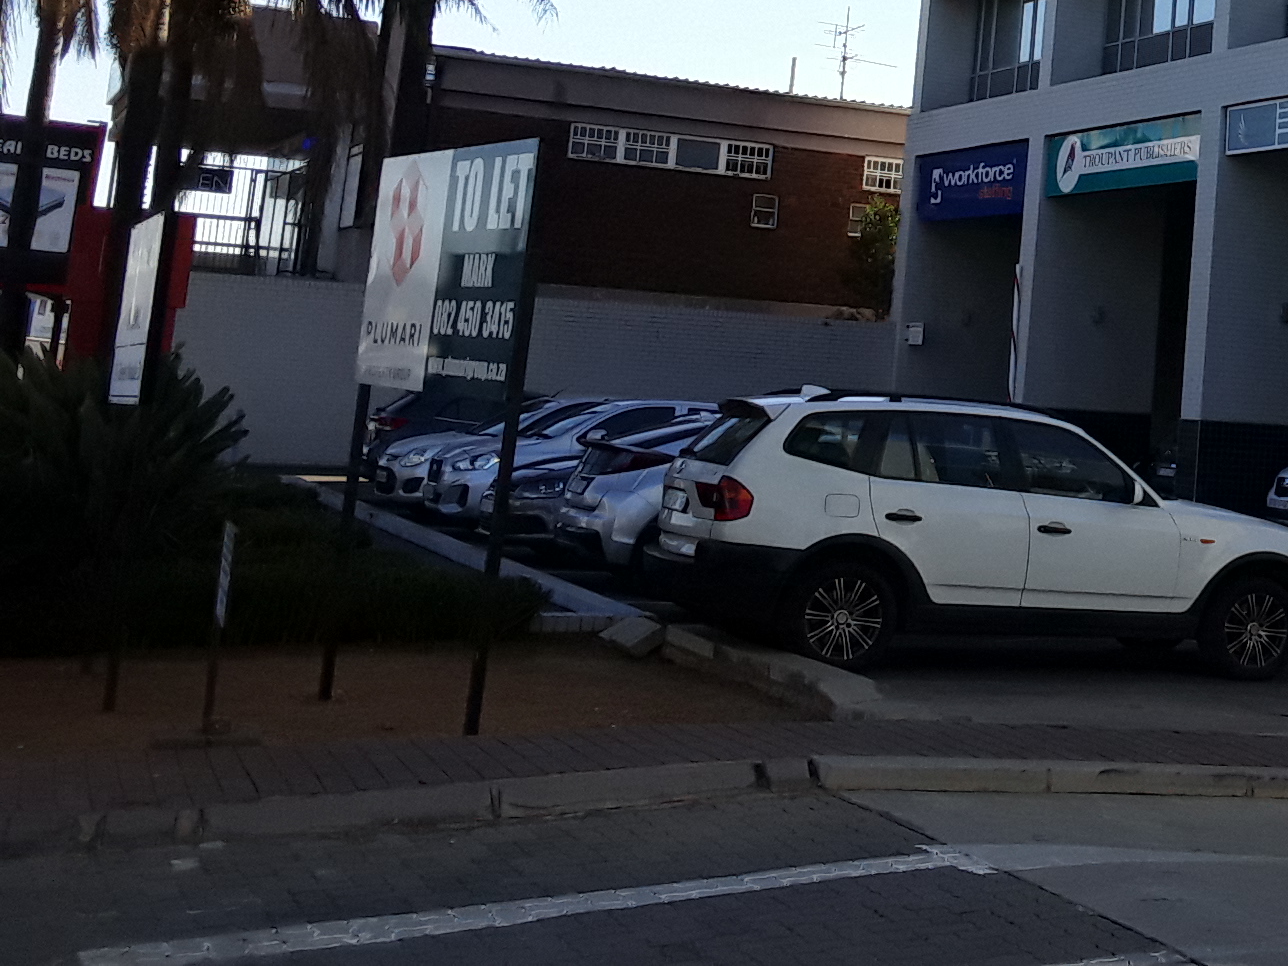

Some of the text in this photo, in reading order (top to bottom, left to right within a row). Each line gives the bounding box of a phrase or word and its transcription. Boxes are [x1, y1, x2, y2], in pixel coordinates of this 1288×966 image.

[45, 144, 94, 163] BEDS
[1083, 140, 1193, 168] TROUPANT PUBLISHERS
[943, 162, 1014, 187] workforce
[452, 152, 535, 232] TO LET
[460, 252, 497, 288] MARK
[366, 320, 423, 347] PLUMARI
[432, 299, 516, 340] 082 450 3415
